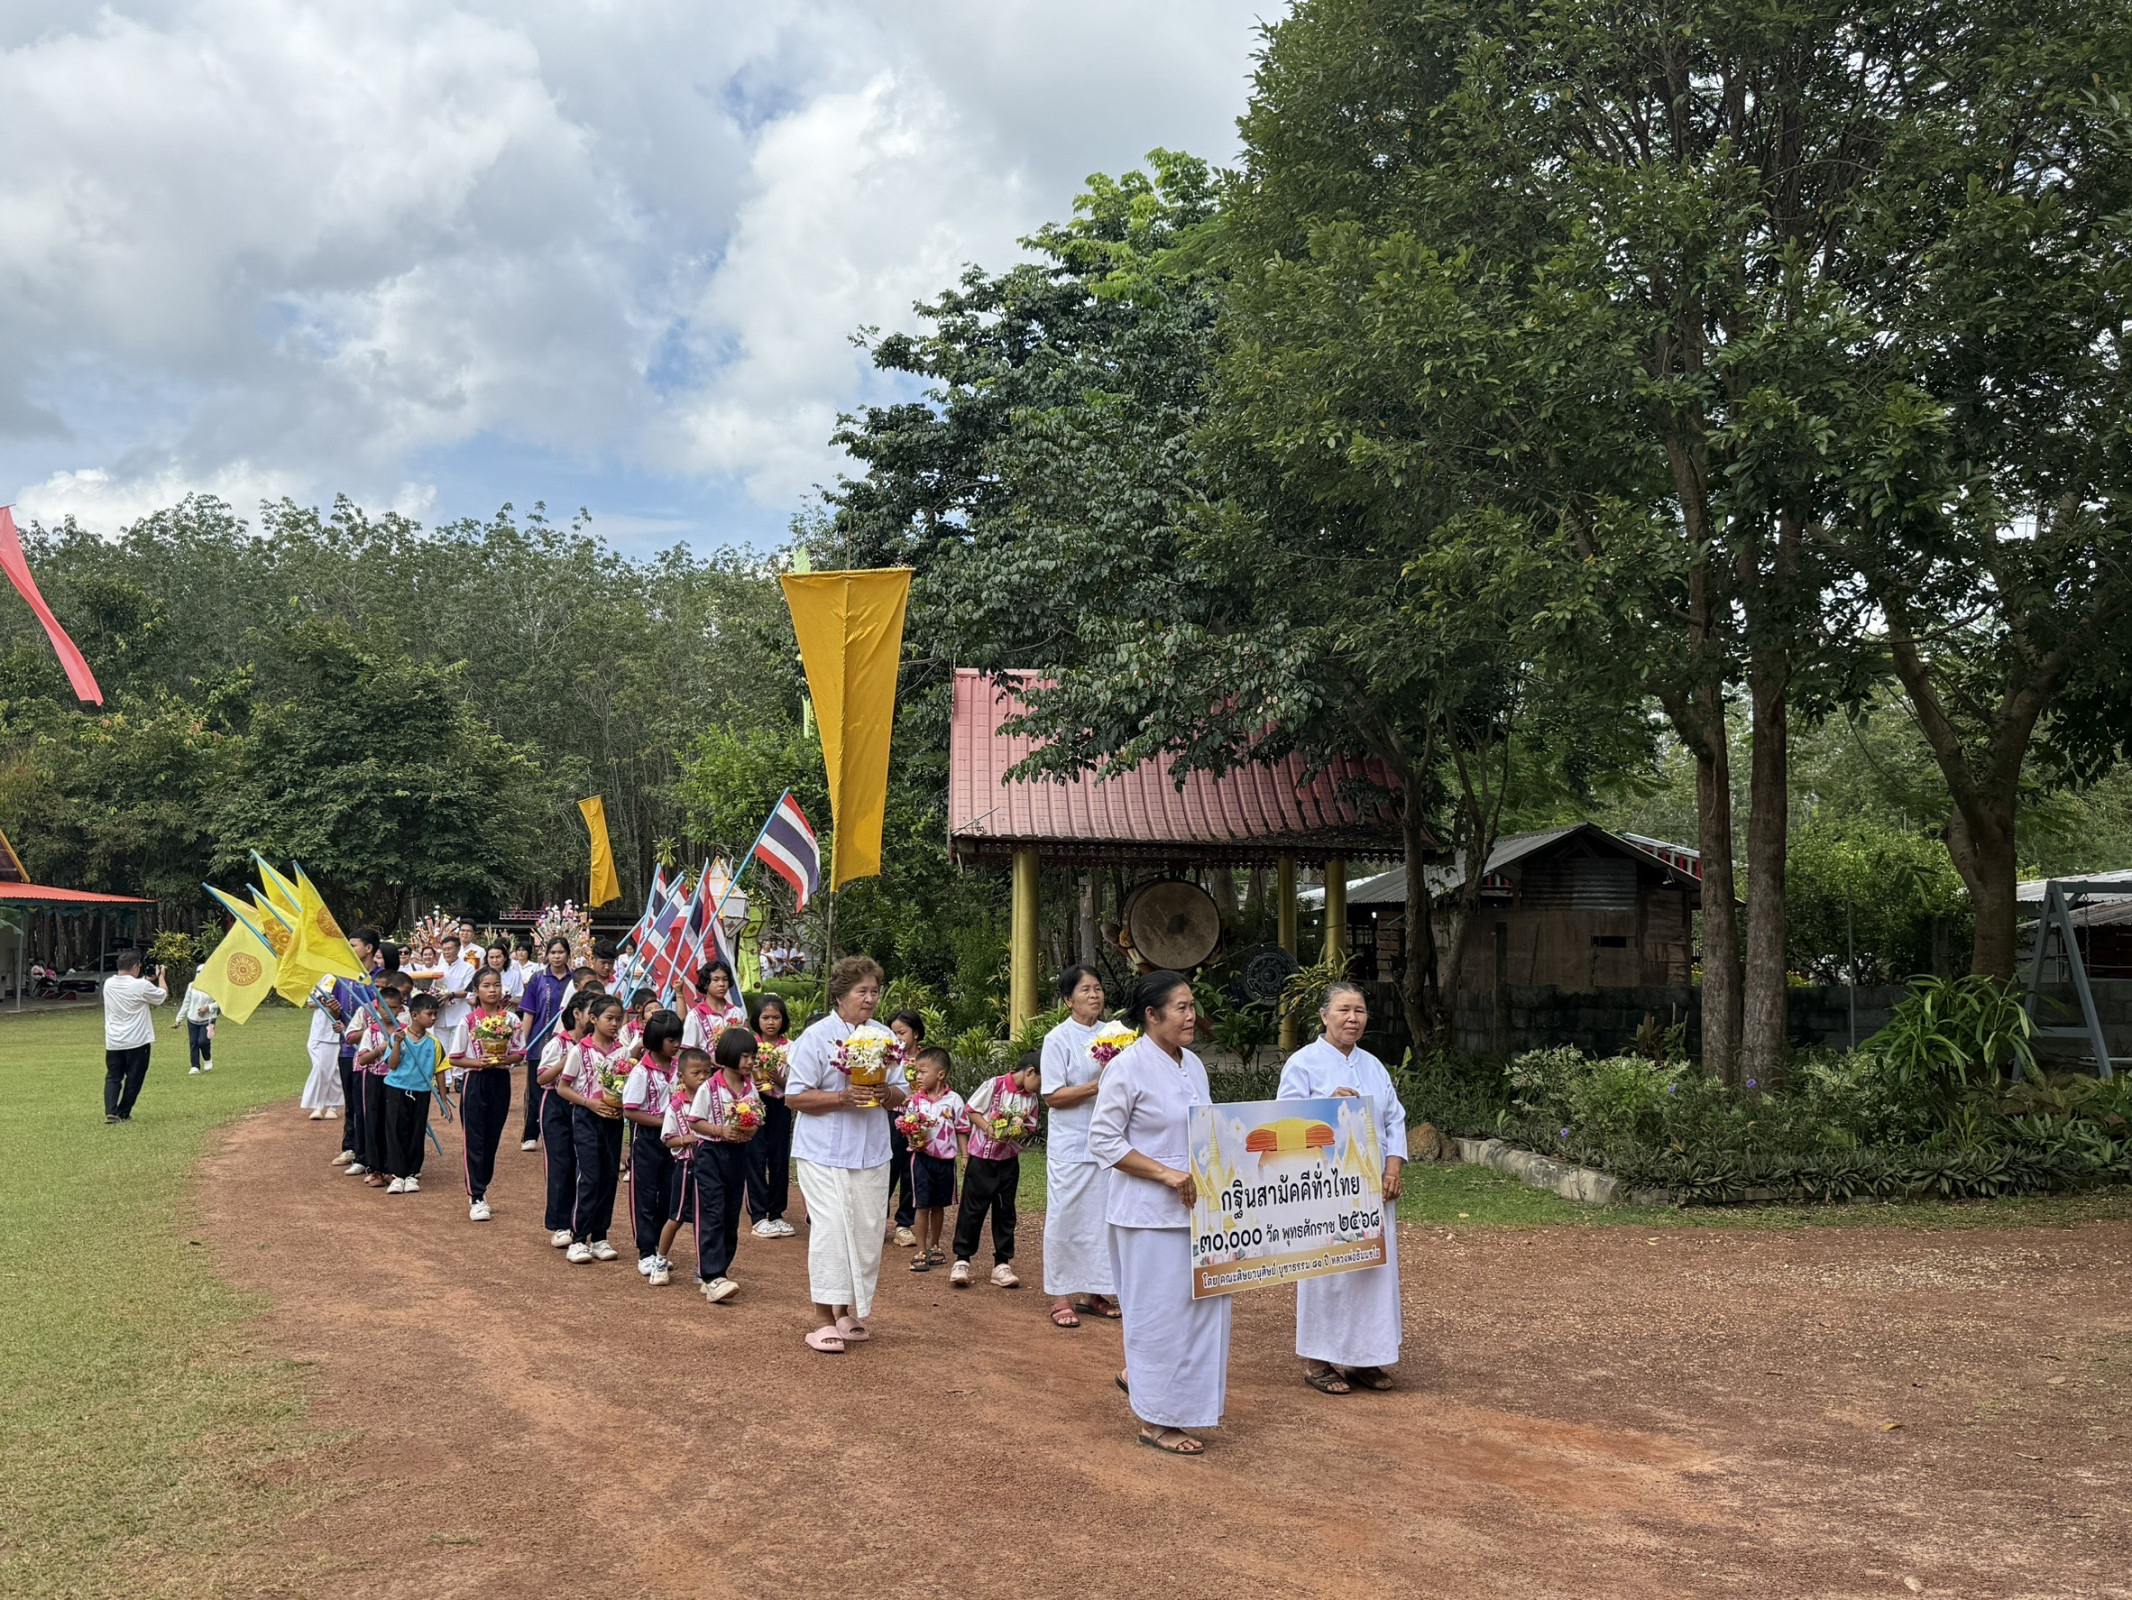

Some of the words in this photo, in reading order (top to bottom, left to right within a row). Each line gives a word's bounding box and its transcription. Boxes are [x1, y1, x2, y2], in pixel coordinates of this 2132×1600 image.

[1221, 1161, 1360, 1219] กฐินสามัคคีทั่วไทย
[1199, 1228, 1262, 1254] ๓๐,๐๐๐
[1266, 1224, 1280, 1243] วัด
[1282, 1218, 1335, 1247] พุทธศักราช
[1338, 1209, 1380, 1232] ๒๕๖๘
[1203, 1273, 1218, 1288] โดย
[1278, 1260, 1310, 1278] บูชาธรรม
[1323, 1253, 1329, 1266] ปี
